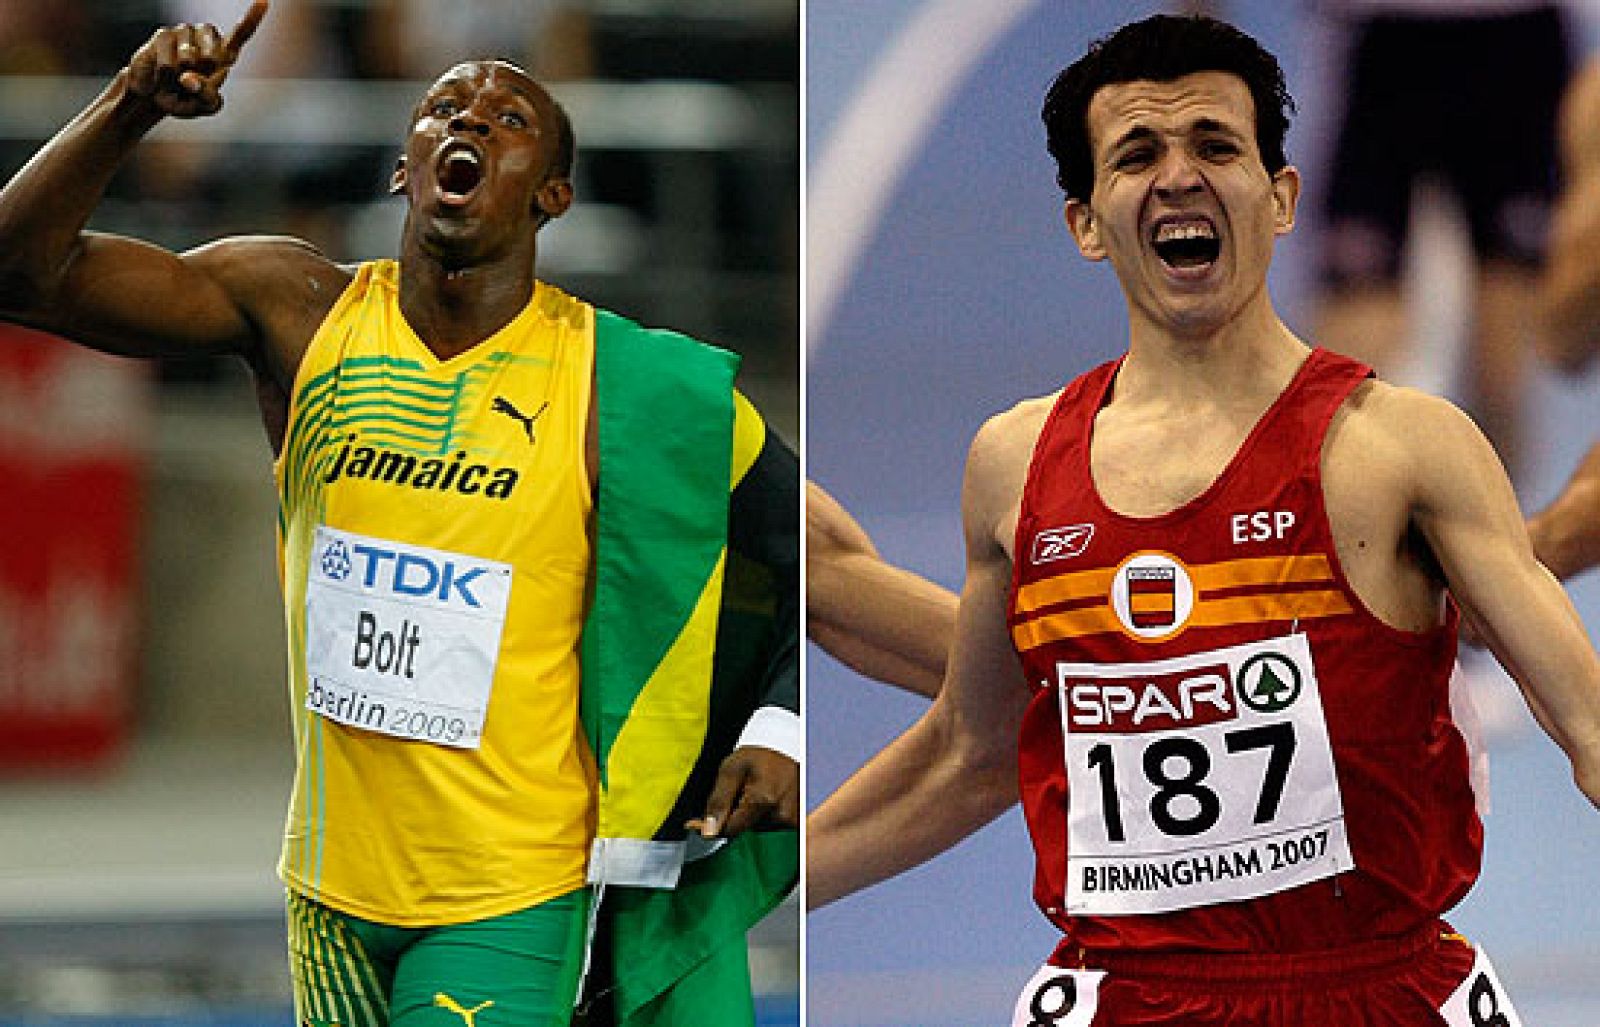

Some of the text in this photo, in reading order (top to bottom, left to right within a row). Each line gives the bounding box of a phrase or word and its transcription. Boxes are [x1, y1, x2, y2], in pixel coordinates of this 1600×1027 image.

[325, 434, 519, 499] jamaica
[1231, 511, 1296, 544] ESP
[353, 543, 490, 608] TDK
[352, 611, 420, 678] Bolt
[307, 678, 466, 742] berlin 2009
[1071, 674, 1231, 726] SPAR
[1087, 721, 1299, 842] 187
[1082, 831, 1330, 893] BIRMINGHAM 2007
